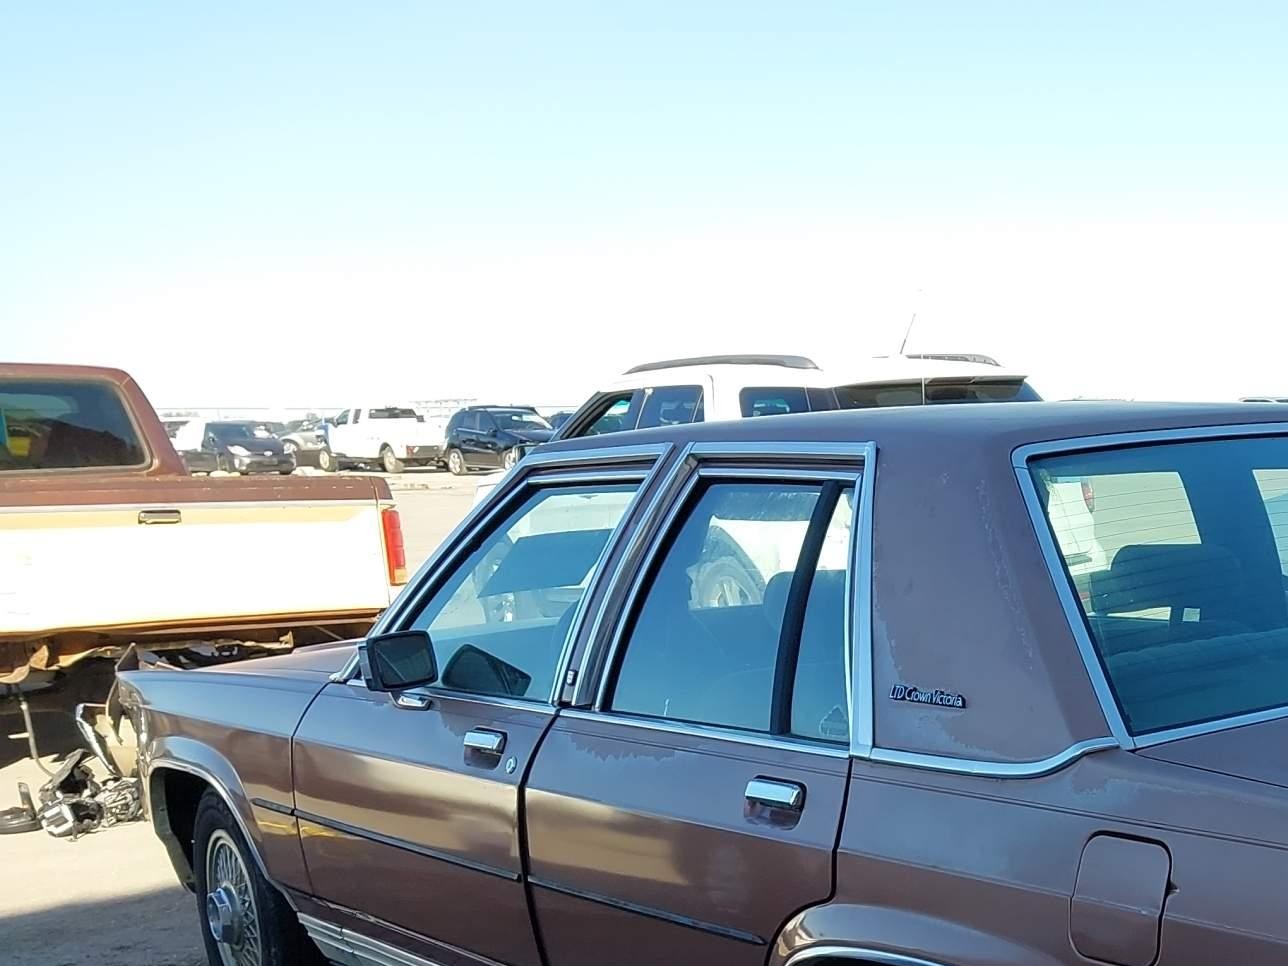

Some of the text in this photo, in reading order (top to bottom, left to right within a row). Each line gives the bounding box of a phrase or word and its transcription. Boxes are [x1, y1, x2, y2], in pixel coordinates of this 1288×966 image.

[889, 685, 963, 707] LTD Crown Victoria
